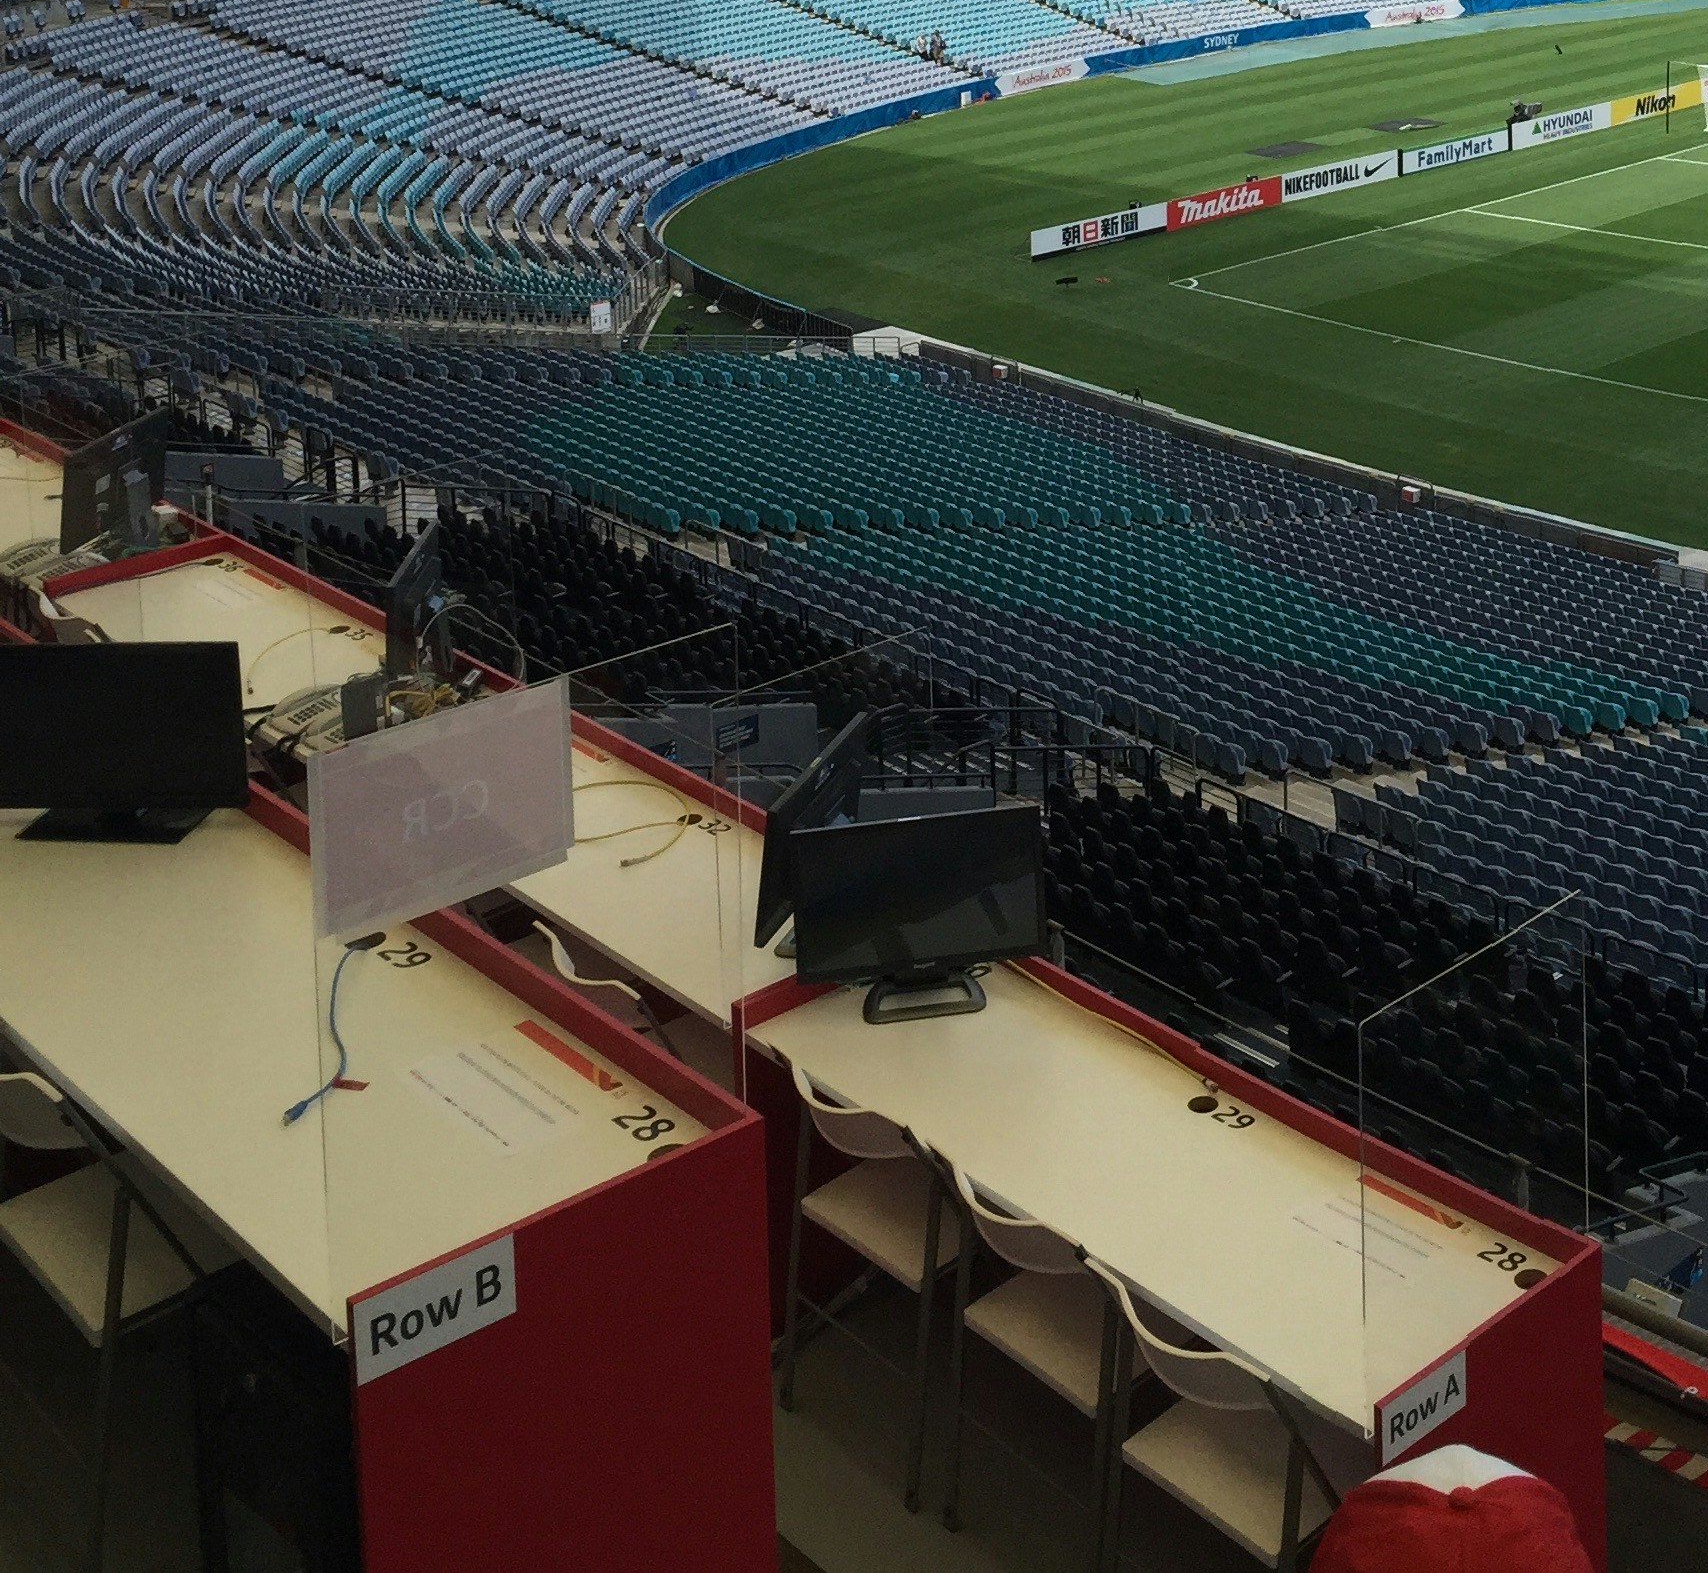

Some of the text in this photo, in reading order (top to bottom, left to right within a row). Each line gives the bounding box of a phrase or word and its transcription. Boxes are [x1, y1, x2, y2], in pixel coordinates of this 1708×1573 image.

[1204, 33, 1239, 48] SYDNEY
[1635, 94, 1676, 116] Nikon
[1543, 109, 1593, 133] HYUNDAI
[1417, 137, 1493, 168] FamilyMart
[1284, 164, 1360, 196] NIKEFOOTBALL
[1062, 211, 1139, 247] 朝日新聞
[345, 629, 373, 641] 35
[698, 819, 732, 836] 32
[377, 941, 432, 969] 29
[611, 1105, 675, 1141] 28
[1211, 1105, 1255, 1129] 29
[1477, 1242, 1527, 1271] 28
[370, 1264, 502, 1355] Row B
[1390, 1373, 1461, 1445] Row A
